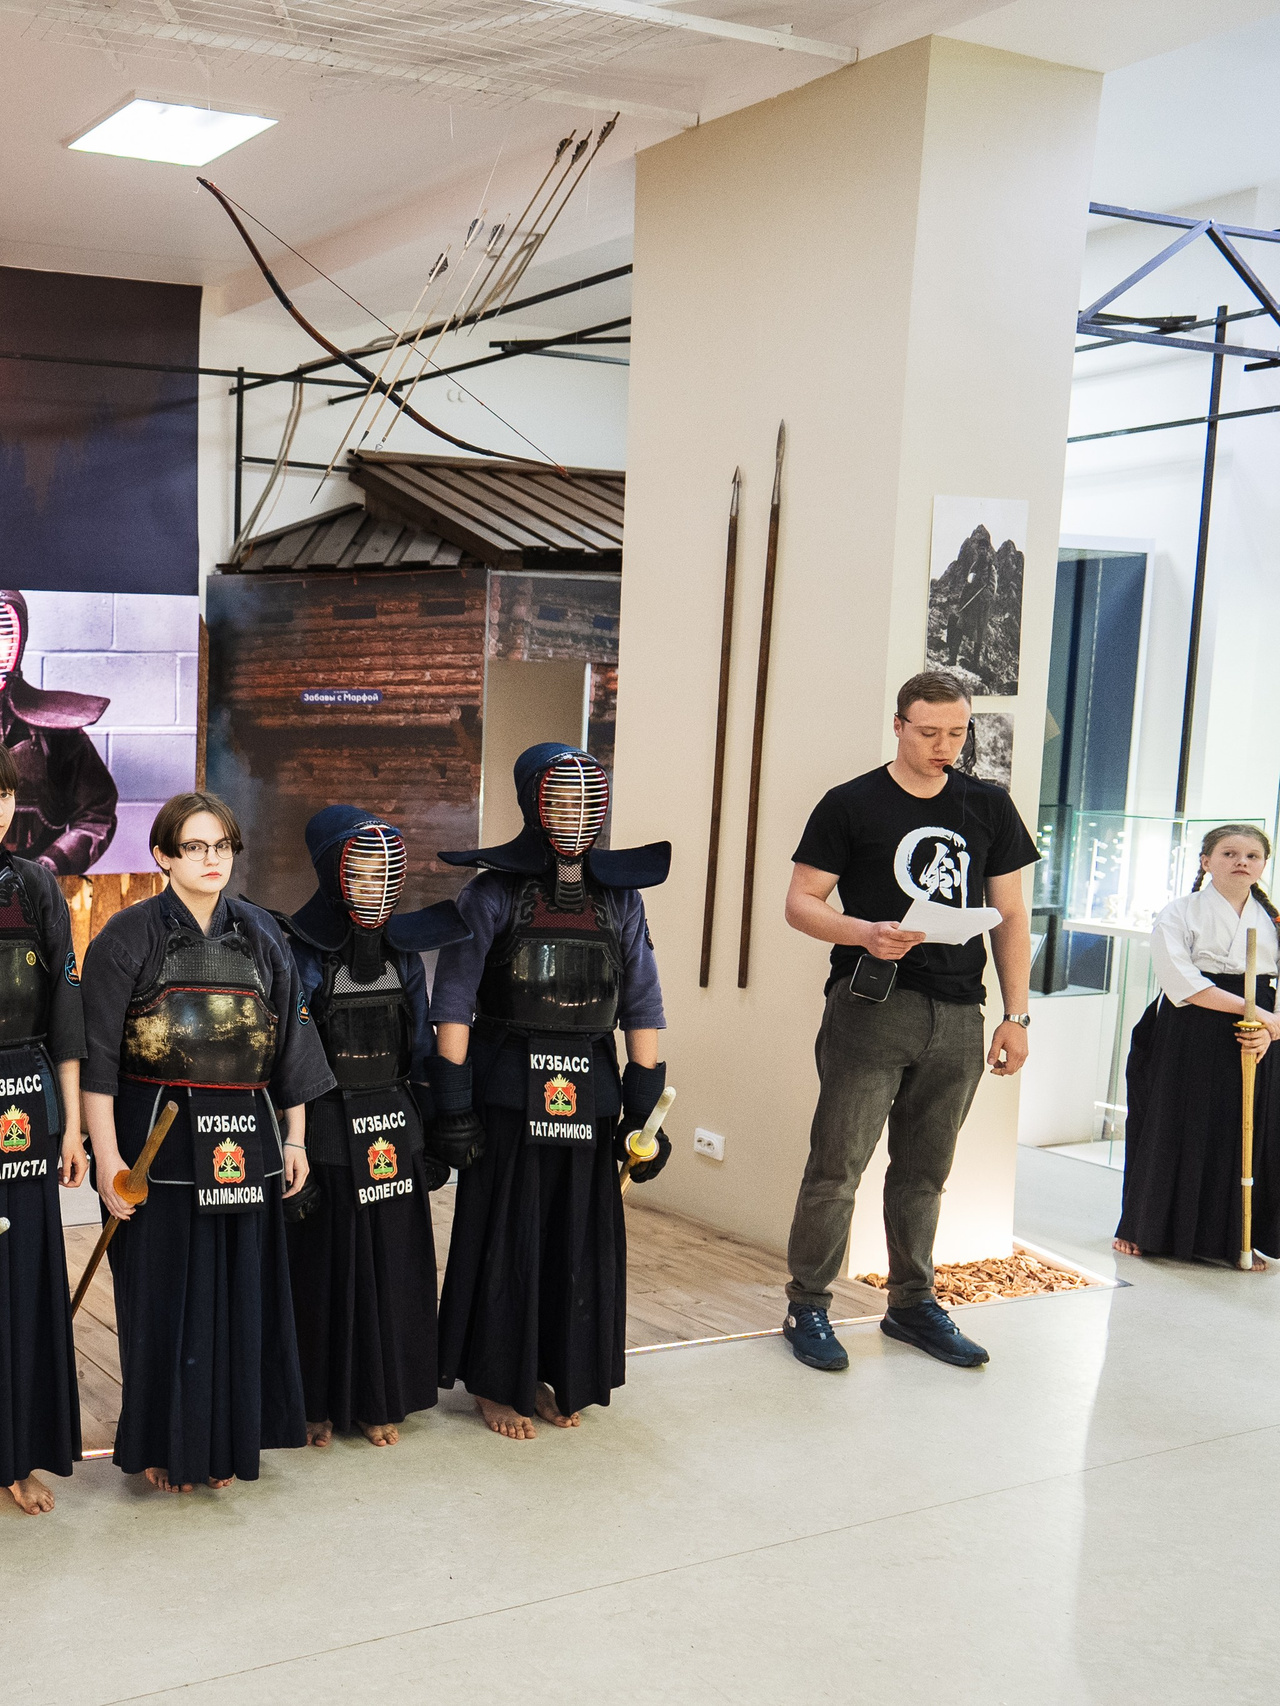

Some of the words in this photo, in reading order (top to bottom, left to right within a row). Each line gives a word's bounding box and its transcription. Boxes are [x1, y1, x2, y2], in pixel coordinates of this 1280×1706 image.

[304, 692, 336, 701] Забавы
[343, 692, 378, 703] Марфой
[530, 1053, 589, 1073] КУЗБАСС
[197, 1114, 256, 1133] КУЗБАСС
[352, 1110, 406, 1134] КУЗБАСС
[529, 1120, 593, 1140] ТАТАРНИКОВ
[198, 1186, 264, 1206] КАЛМЫКОВА
[358, 1178, 413, 1204] ВОЛЕГОВ
